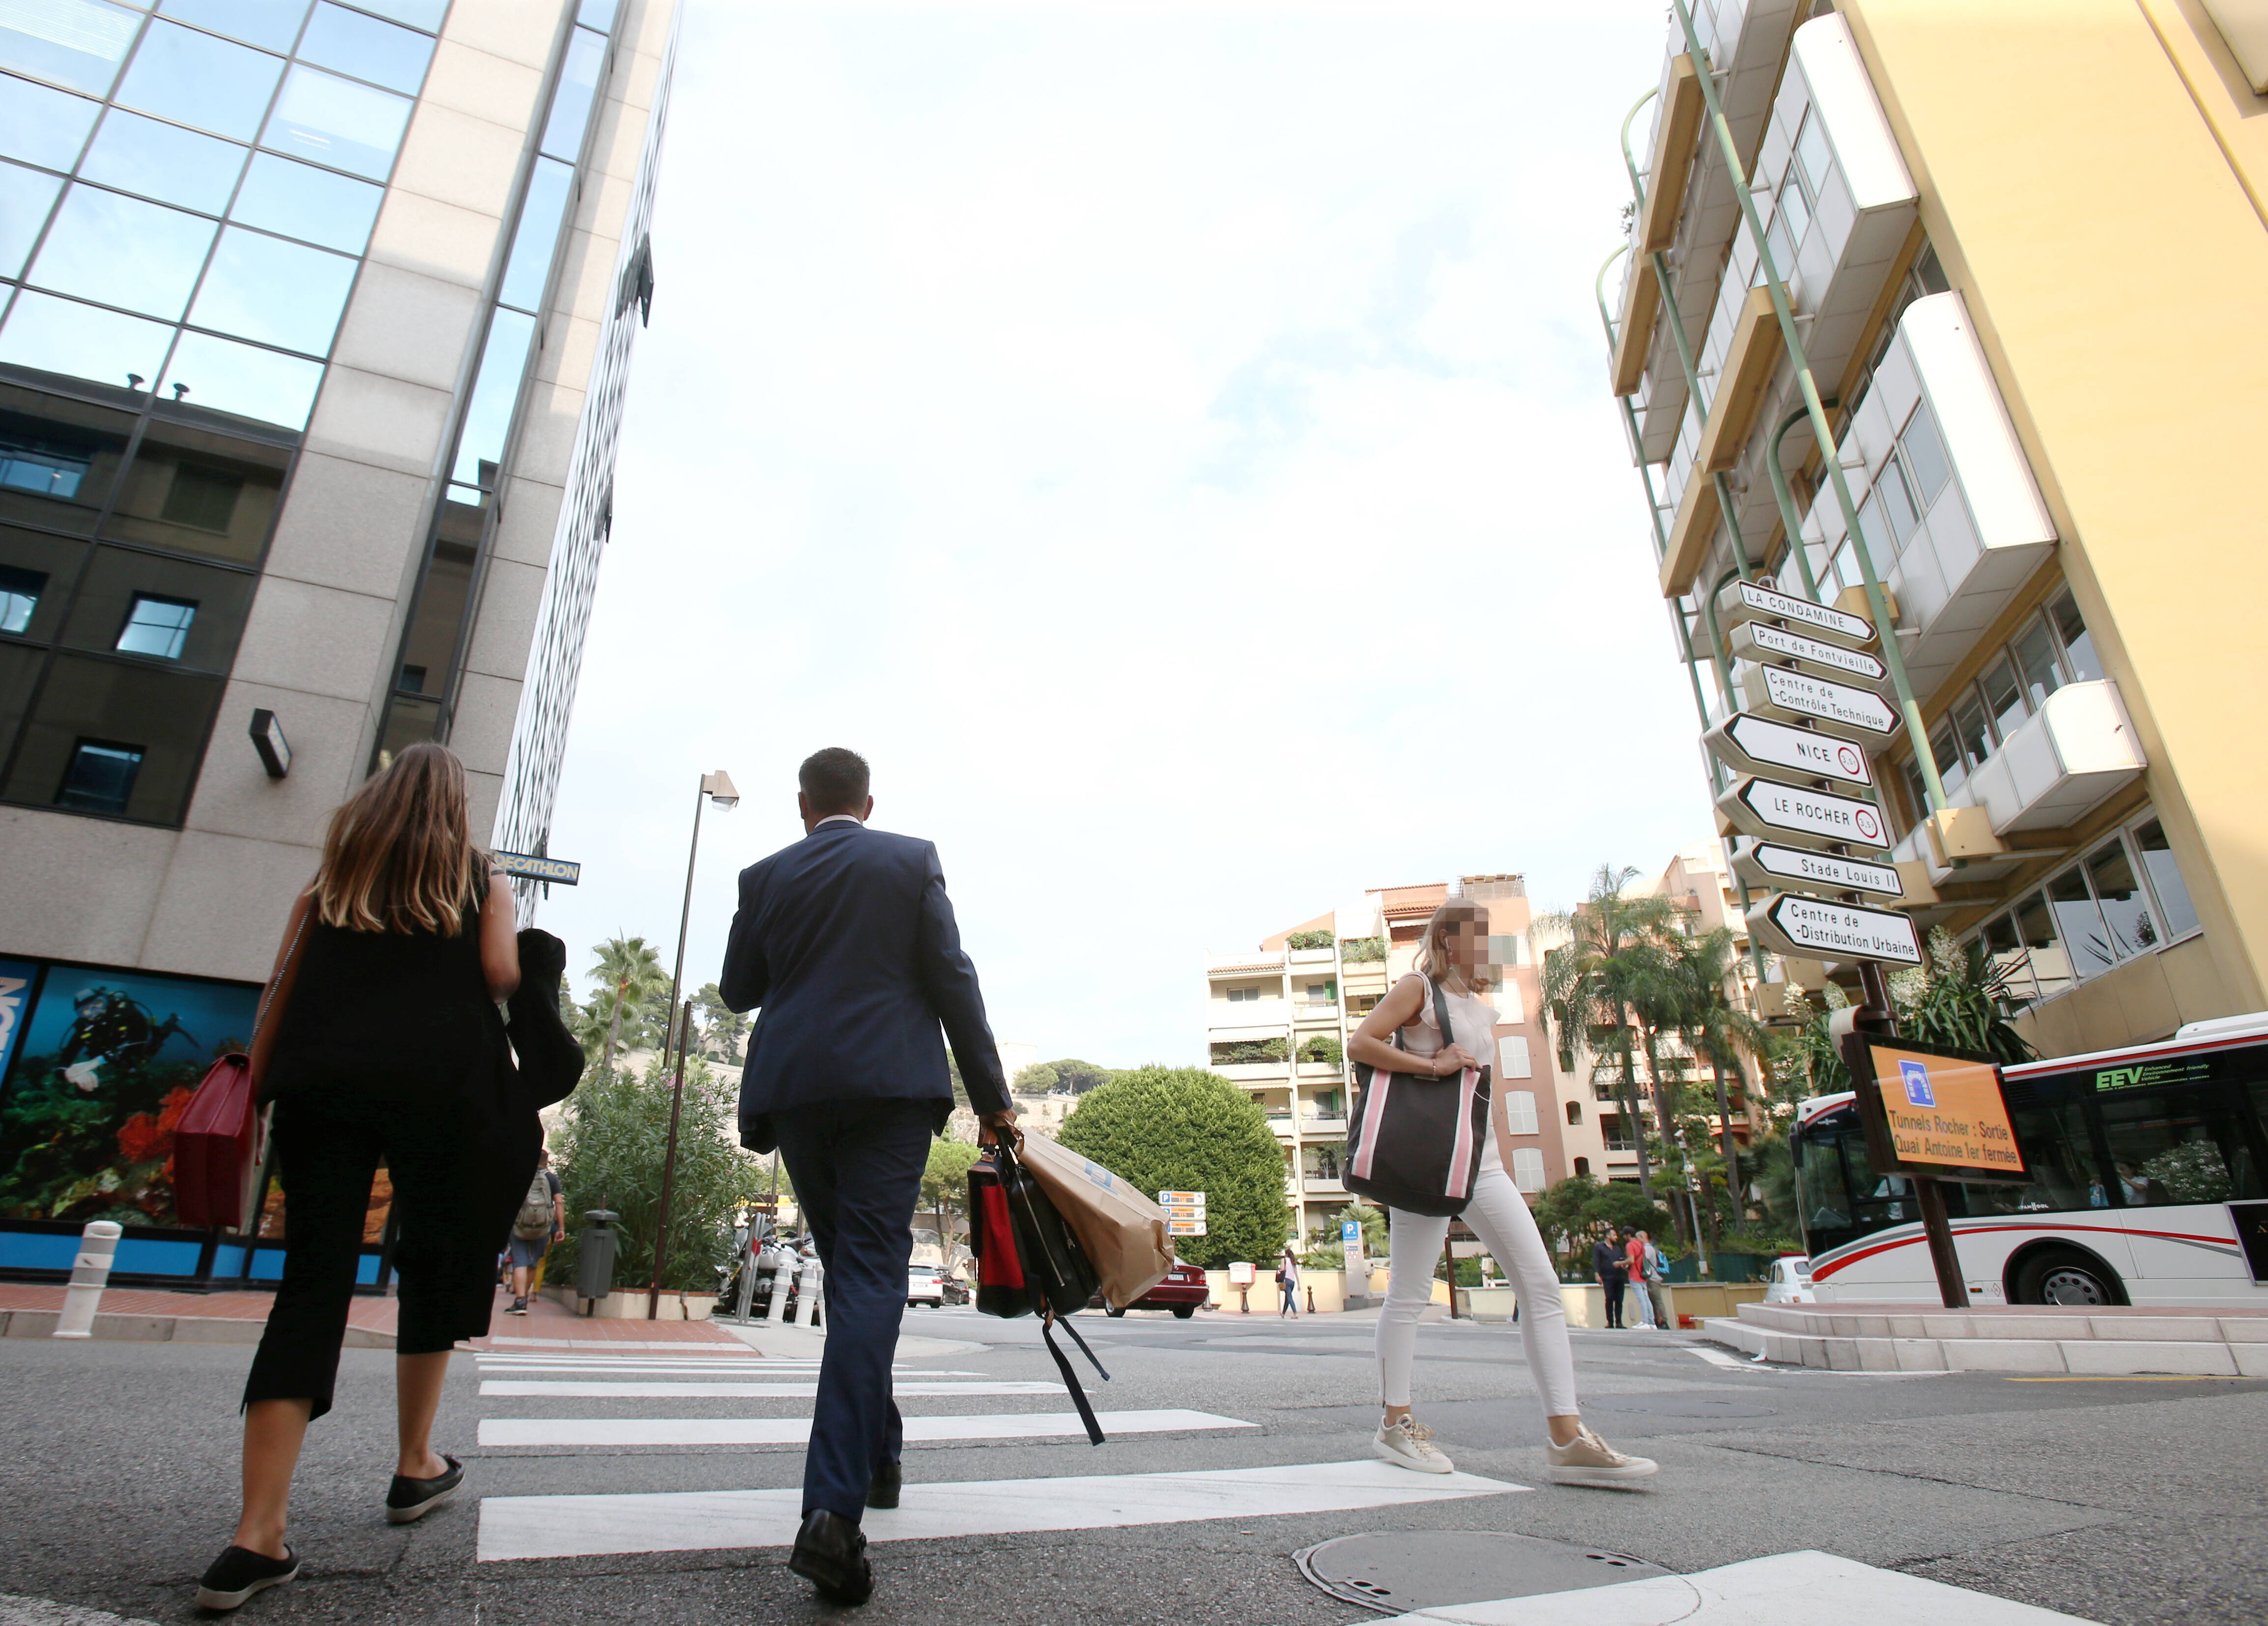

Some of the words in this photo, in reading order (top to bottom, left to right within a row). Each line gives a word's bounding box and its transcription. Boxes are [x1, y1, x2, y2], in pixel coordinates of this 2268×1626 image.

[1747, 590, 1763, 604] LA
[1769, 597, 1845, 627] CONDAMINE
[1758, 629, 1785, 647] Port
[1792, 639, 1805, 652] de
[1810, 644, 1874, 672] Fontvieille
[1770, 673, 1813, 693] Centre
[1820, 686, 1833, 699] de
[1830, 703, 1884, 727] Technique
[1797, 742, 1831, 763] NICE
[1774, 798, 1789, 813] LE
[1796, 802, 1850, 826] ROCHER
[494, 853, 579, 879] DECATHLON
[1801, 858, 1839, 878] Stade
[1846, 867, 1880, 885] Louis
[1886, 874, 1896, 888] II
[1791, 904, 1837, 924] Centre
[1844, 914, 1859, 928] de
[1872, 936, 1915, 956] Urbaine
[2096, 1066, 2144, 1089] EEV
[1889, 1110, 1932, 1131] Tunnels
[1934, 1115, 1969, 1136] Rocher
[1978, 1121, 2008, 1140] Sortie
[1894, 1134, 1920, 1154] Quai
[1925, 1137, 1963, 1158] Antoine
[1964, 1142, 1980, 1160] 1er
[1982, 1143, 2017, 1164] fermée
